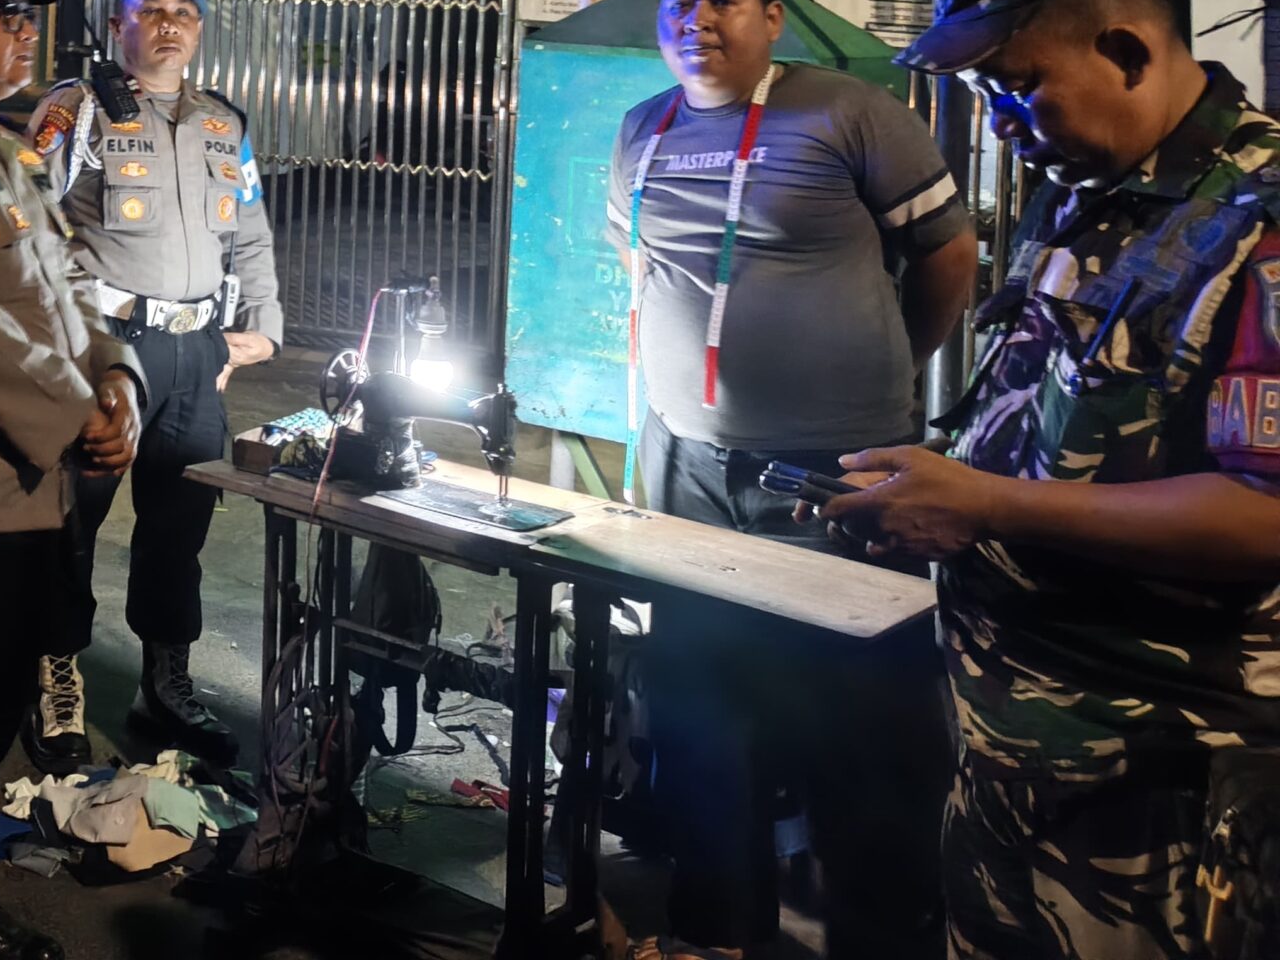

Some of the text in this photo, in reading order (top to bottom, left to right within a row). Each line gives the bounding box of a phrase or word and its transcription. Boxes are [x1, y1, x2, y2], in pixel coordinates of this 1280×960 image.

[106, 139, 155, 153] ELFIN
[205, 140, 237, 157] POLRI
[665, 146, 769, 171] MASTERPCE
